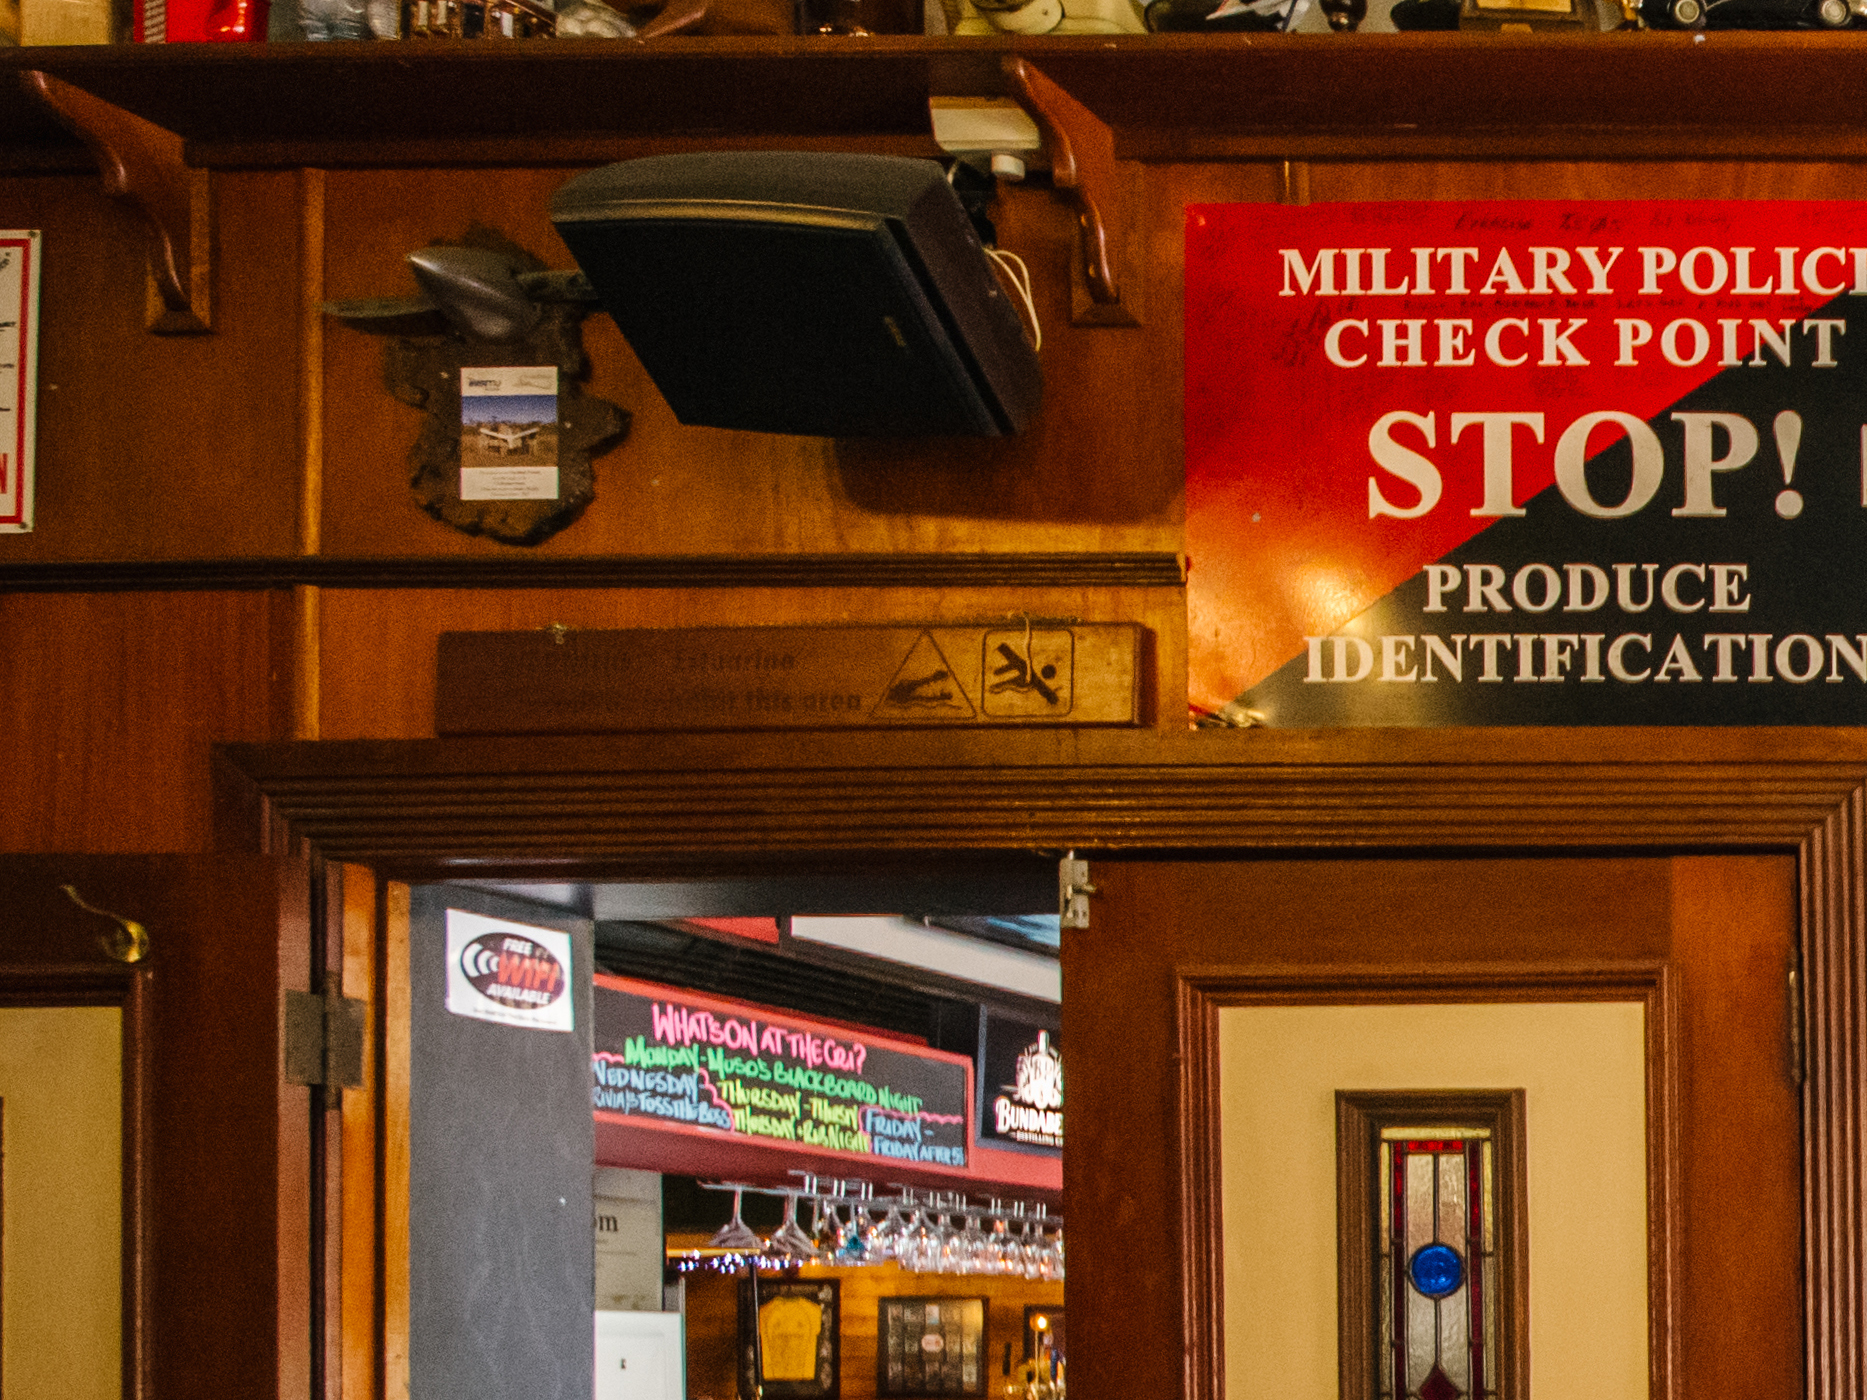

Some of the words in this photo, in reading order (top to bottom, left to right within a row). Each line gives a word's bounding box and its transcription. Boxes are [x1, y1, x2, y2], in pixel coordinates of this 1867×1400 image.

[1279, 246, 1624, 297] MILITARY
[1325, 318, 1590, 368] CHECK
[1614, 318, 1846, 368] POINT
[1368, 410, 1804, 520] STOP!
[1422, 563, 1752, 614] PRODUCE
[503, 938, 533, 956] FREE
[486, 983, 551, 1004] AVAILABLE
[725, 1019, 758, 1056] ON
[761, 1026, 787, 1056] AT
